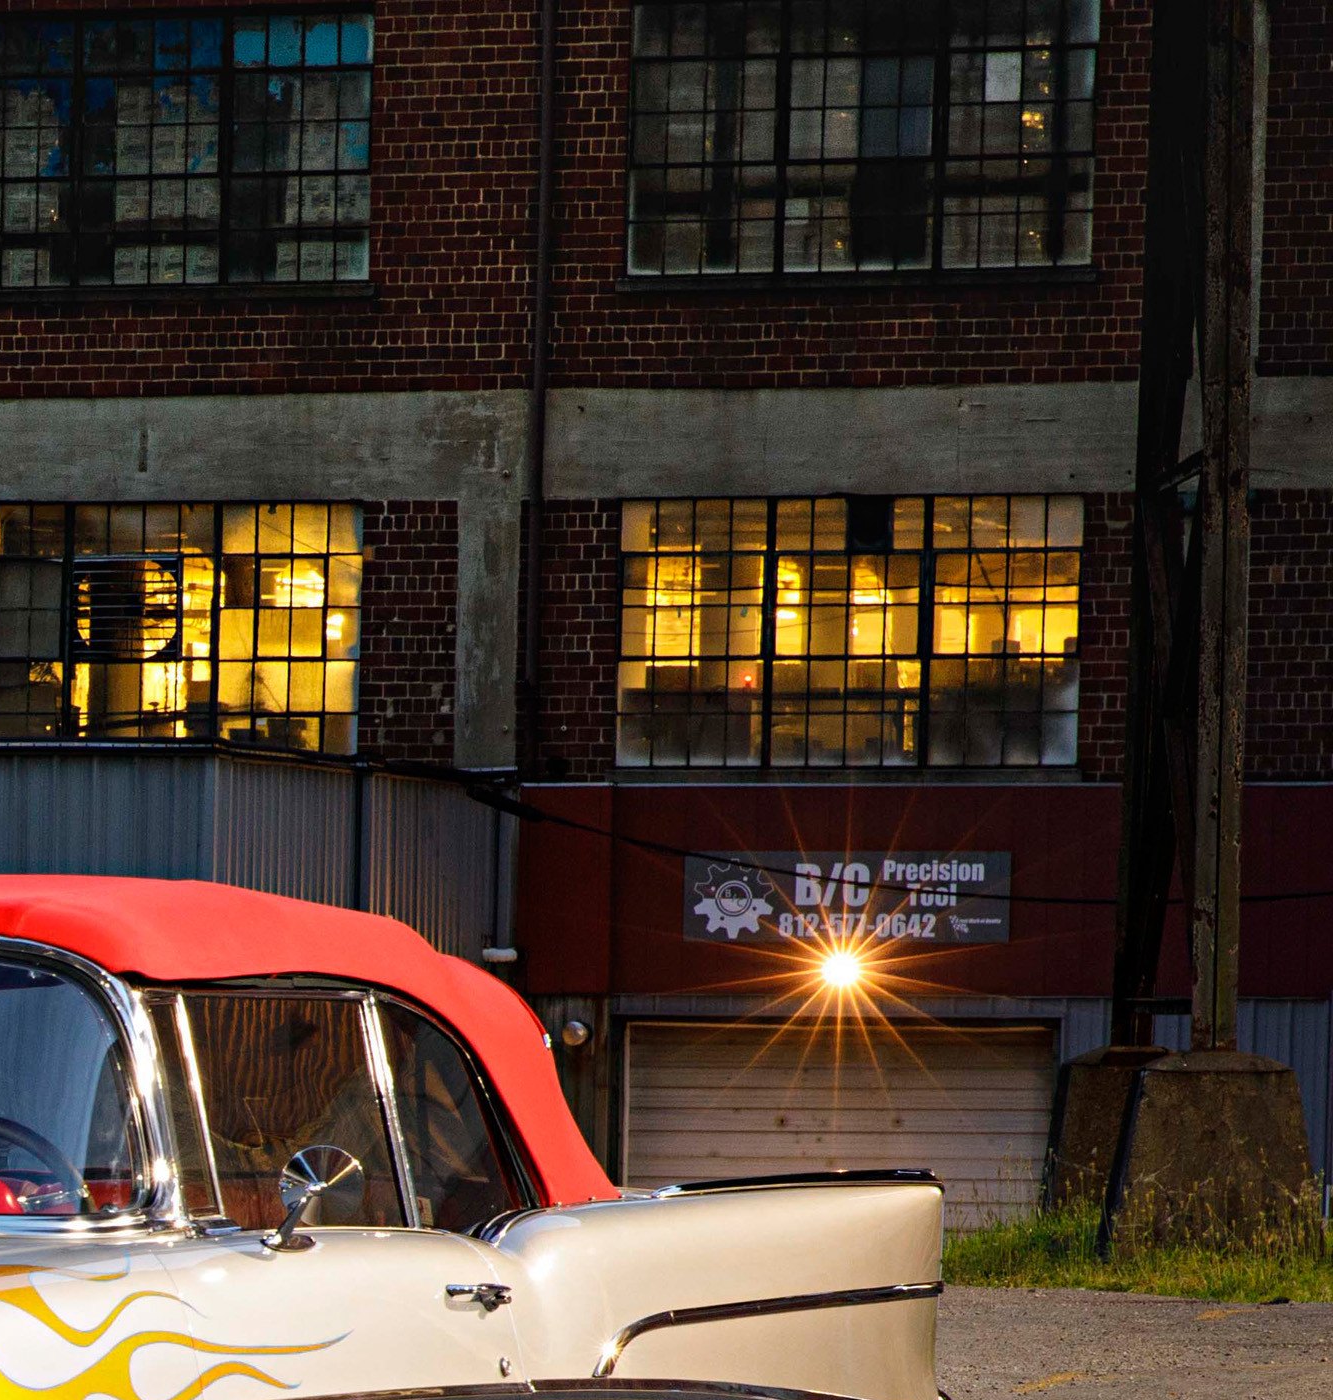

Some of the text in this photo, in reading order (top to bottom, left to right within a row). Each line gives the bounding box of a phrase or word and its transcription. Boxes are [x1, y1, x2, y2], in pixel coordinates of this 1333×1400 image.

[883, 859, 985, 882] Precision
[795, 863, 871, 907] B/C
[907, 883, 958, 907] Tool
[778, 913, 936, 938] 812-577-0642
